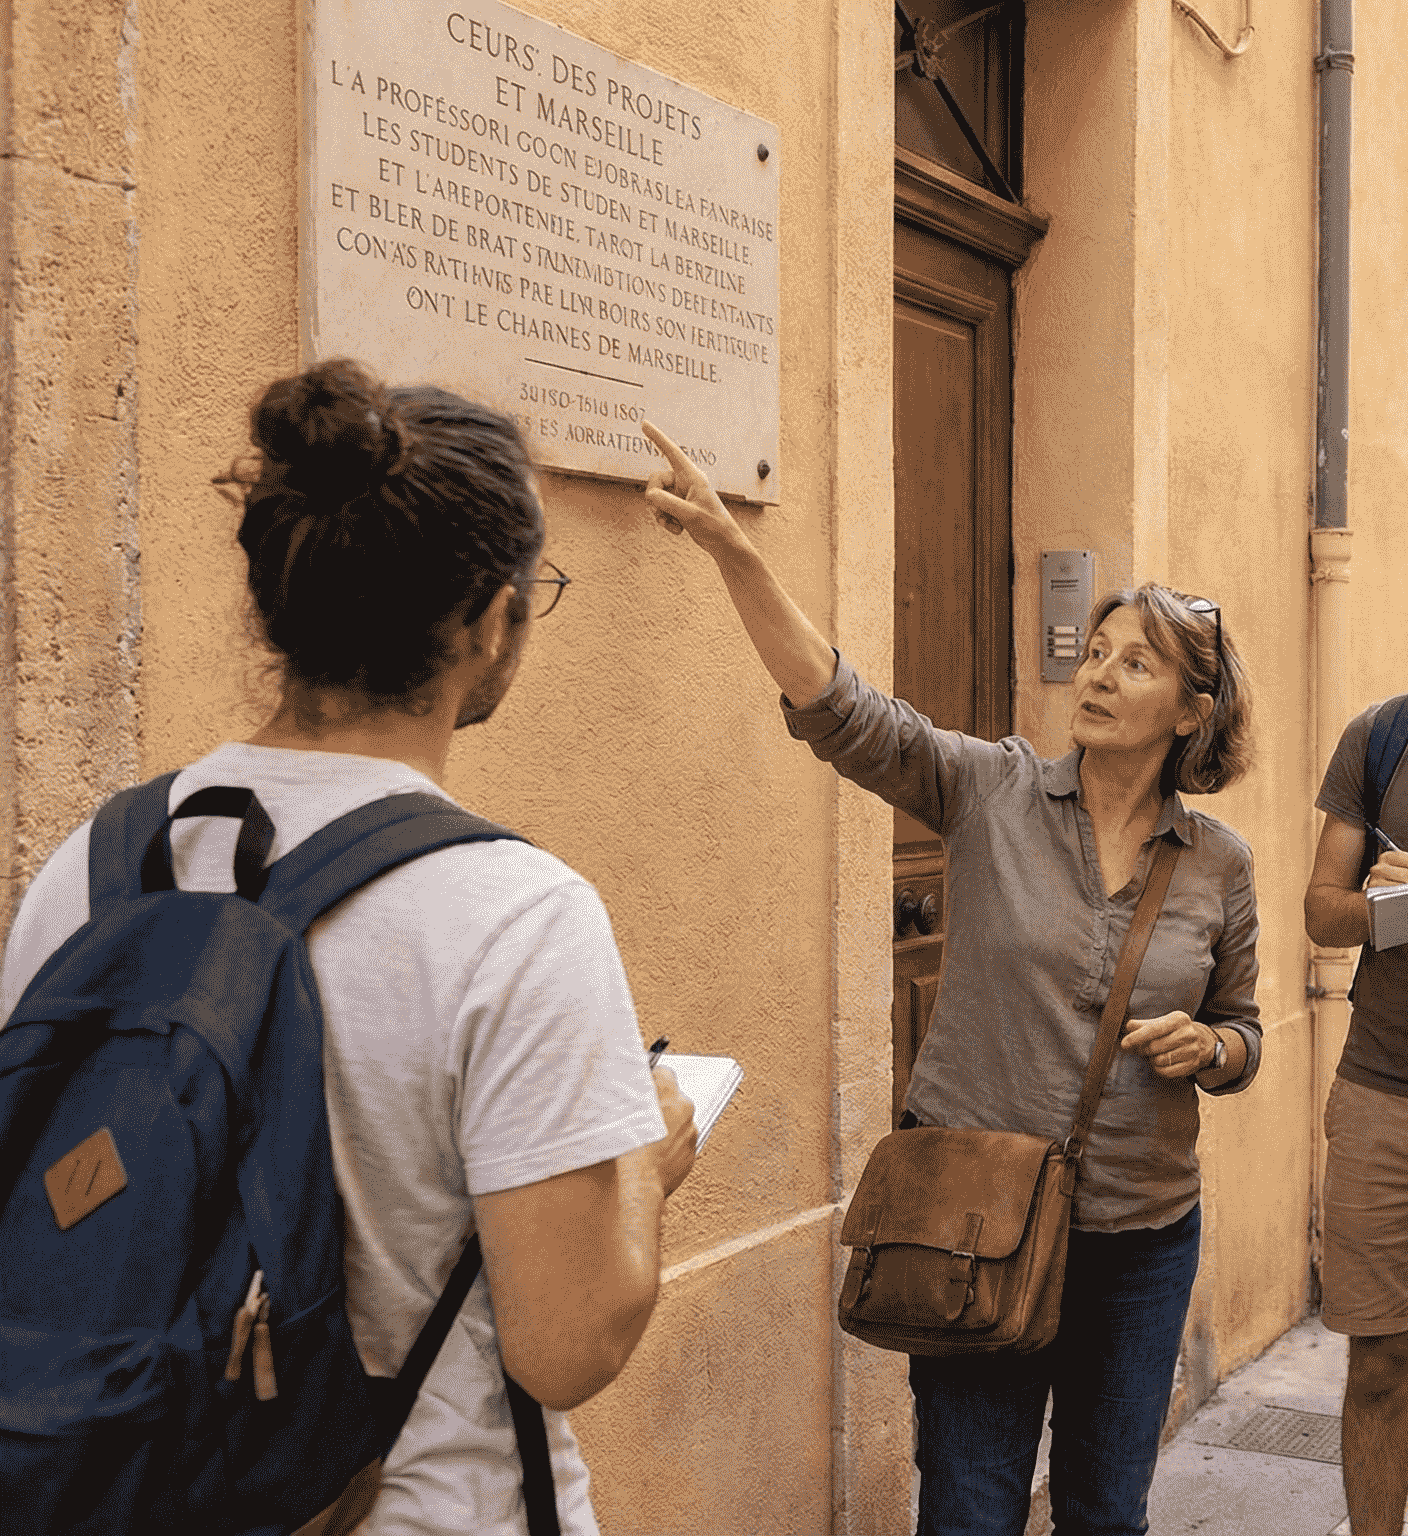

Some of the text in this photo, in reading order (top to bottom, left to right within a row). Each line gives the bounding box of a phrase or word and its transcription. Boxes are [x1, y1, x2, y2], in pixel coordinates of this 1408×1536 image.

[495, 76, 664, 167] ET MARSEILLE
[552, 54, 597, 97] DES
[607, 78, 702, 141] PROJETS
[362, 112, 402, 146] LES
[409, 129, 519, 186] STUDENTS
[527, 169, 553, 198] DE
[560, 181, 632, 224] STUDEN
[638, 209, 659, 234] ET
[378, 157, 405, 186] ET
[584, 225, 644, 263] TAROT
[650, 247, 670, 272] LA
[331, 183, 359, 213] ET
[368, 194, 426, 234] BLER
[432, 213, 459, 243] DE
[466, 224, 518, 260] BRAT
[406, 285, 456, 319] ONT
[464, 300, 488, 327] LE
[496, 308, 592, 353] CHARNES
[598, 334, 621, 360] DE
[519, 277, 554, 307] PRE
[598, 299, 652, 333] BOIRS
[655, 316, 687, 342] SON
